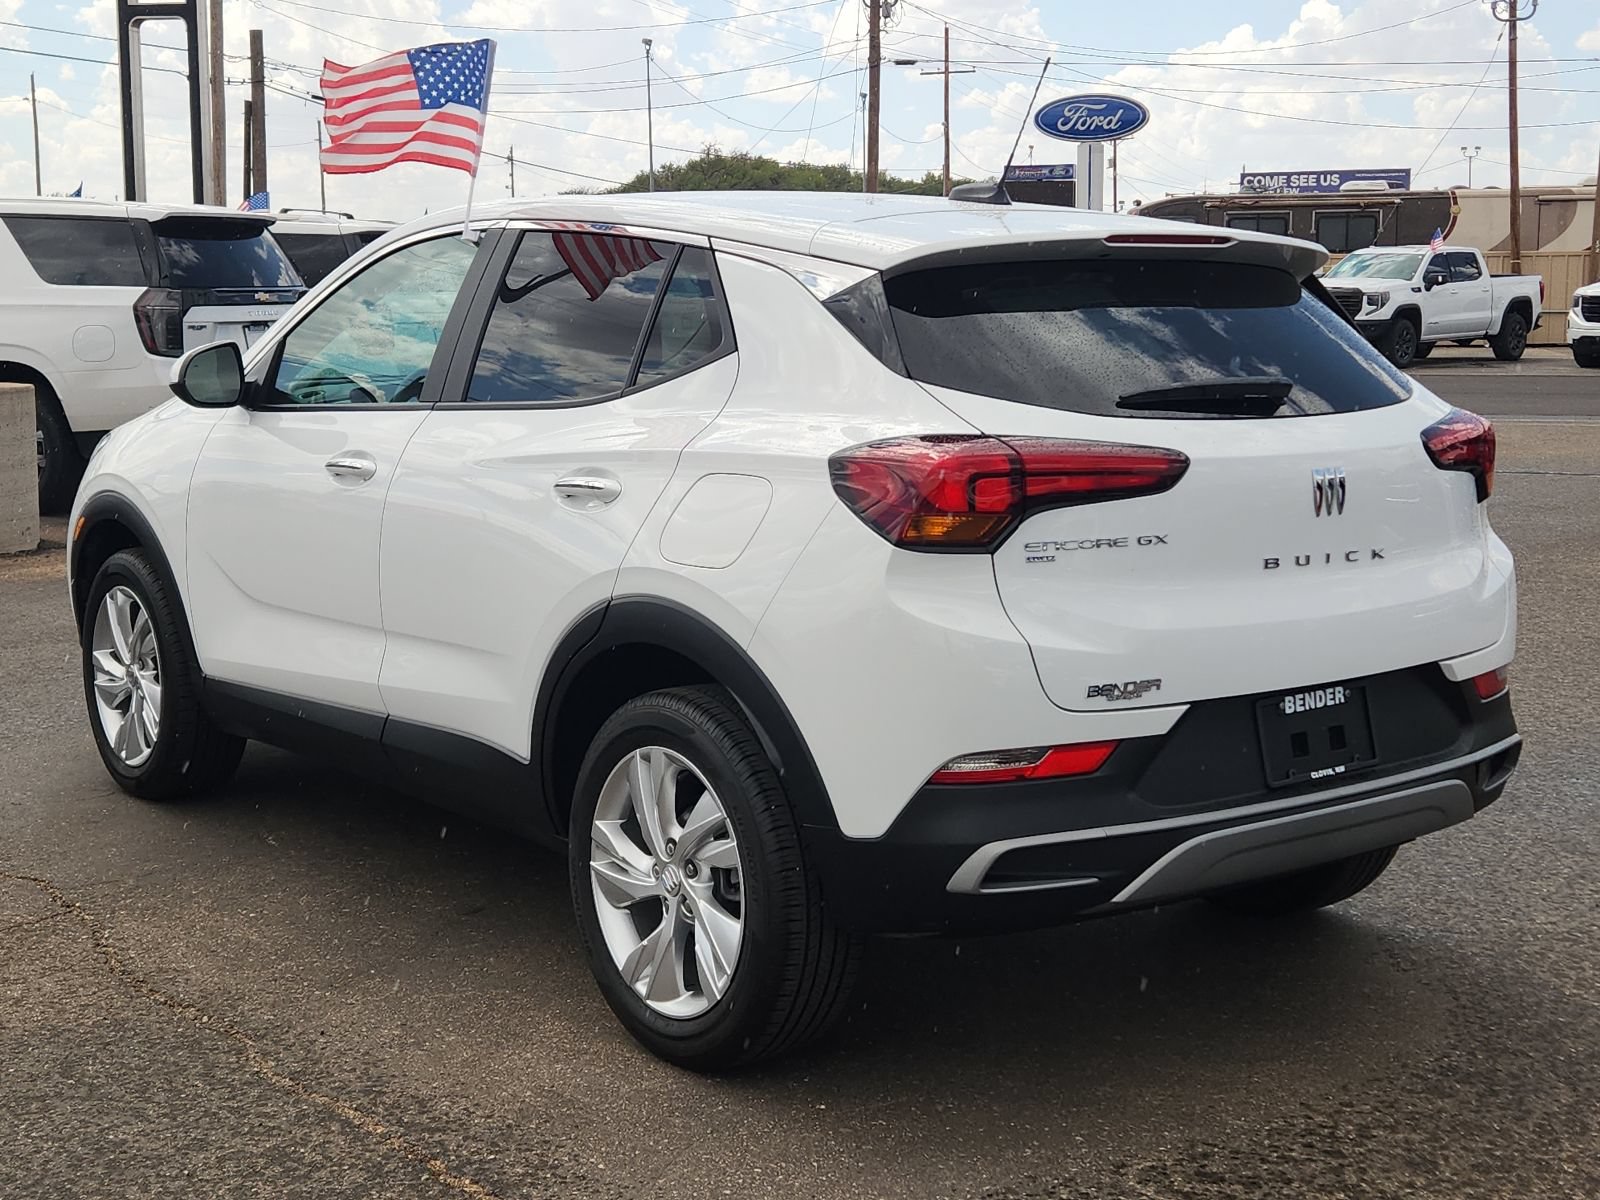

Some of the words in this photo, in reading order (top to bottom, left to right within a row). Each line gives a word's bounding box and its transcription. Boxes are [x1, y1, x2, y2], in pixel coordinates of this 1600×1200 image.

[1057, 103, 1124, 131] Ford
[1243, 175, 1288, 189] COME
[1290, 174, 1318, 187] SEE
[1320, 173, 1340, 187] US
[1024, 536, 1129, 553] ENCORE
[1137, 533, 1169, 547] GX
[1263, 548, 1385, 570] BUICK
[1086, 678, 1162, 699] BENDER
[1284, 686, 1346, 714] BENDER
